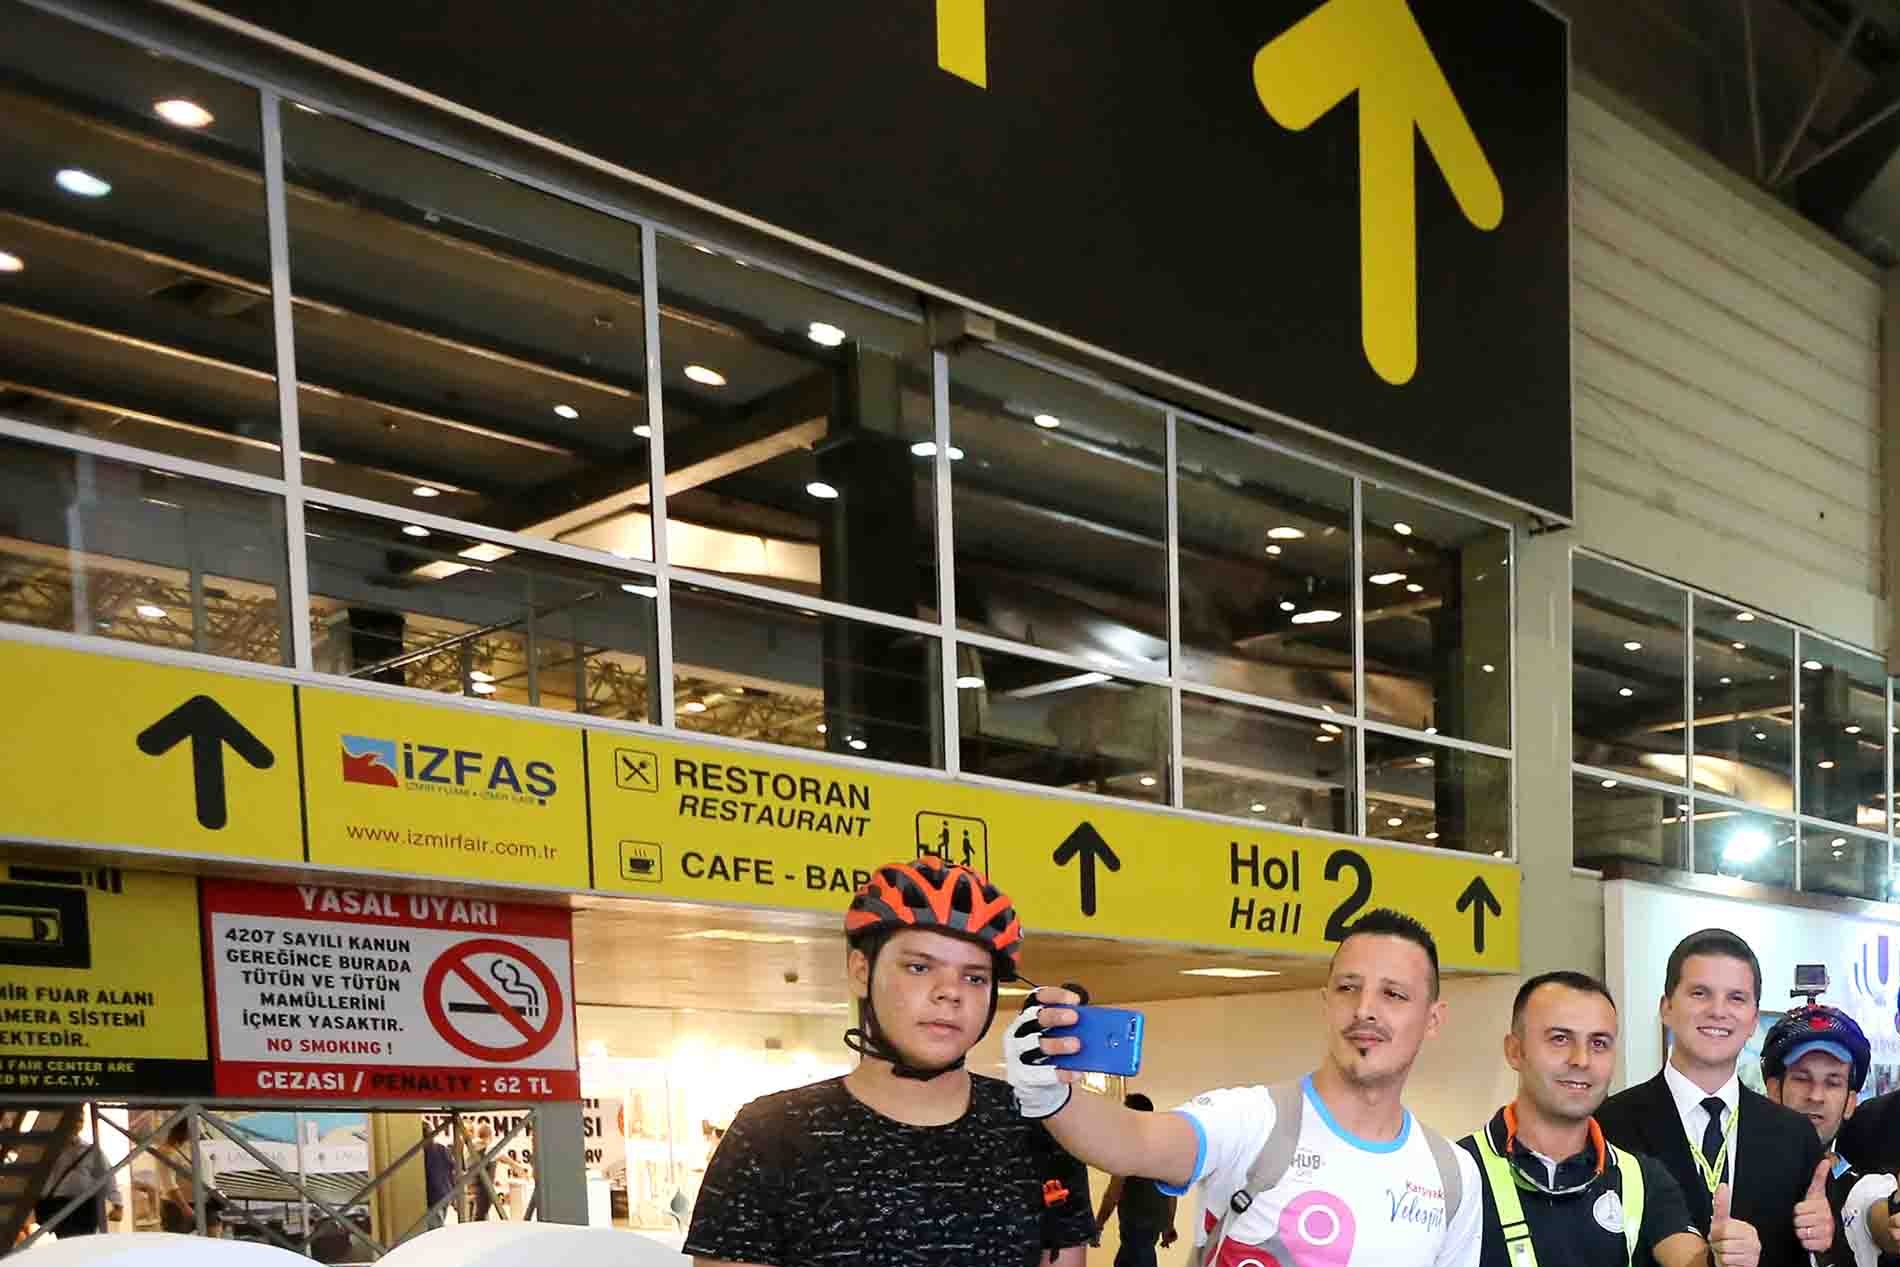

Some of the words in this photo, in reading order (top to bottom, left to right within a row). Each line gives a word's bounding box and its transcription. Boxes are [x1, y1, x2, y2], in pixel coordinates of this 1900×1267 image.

[673, 759, 870, 811] RESTORAN
[678, 795, 871, 838] RESTAURANT
[346, 825, 557, 860] www.izmirfair.com.tr
[680, 851, 774, 885] CAFE
[1231, 842, 1299, 891] Hol
[1324, 849, 1373, 941] 2
[298, 886, 400, 919] YASAL
[409, 900, 497, 926] UYARI
[1230, 897, 1301, 934] Hall
[225, 928, 275, 944] 4207
[283, 932, 342, 949] SAYILI
[349, 936, 410, 953] KANUN
[226, 949, 333, 968] GEREĞİNCE
[339, 956, 411, 973] BURADA
[242, 969, 305, 987] TÜTÜN
[312, 974, 335, 988] VE
[341, 974, 400, 992] TÜTÜN
[36, 987, 88, 1004] FUAR
[99, 989, 154, 1007] ALANI
[260, 992, 385, 1011] MAMÜLLERİNİ
[69, 1008, 145, 1027] SİSTEMİ
[242, 1009, 301, 1029] İÇMEK
[308, 1015, 404, 1032] YASAKTIR.
[267, 1038, 292, 1052] NO
[299, 1039, 381, 1055] SMOKING
[8, 1060, 42, 1072] FAIR
[47, 1061, 102, 1073] CENTER
[107, 1062, 136, 1073] ARE
[19, 1074, 38, 1086] BY
[257, 1071, 345, 1091] CEZASI
[372, 1073, 472, 1092] PENALTY
[494, 1077, 521, 1093] 62
[529, 1078, 553, 1094] TL
